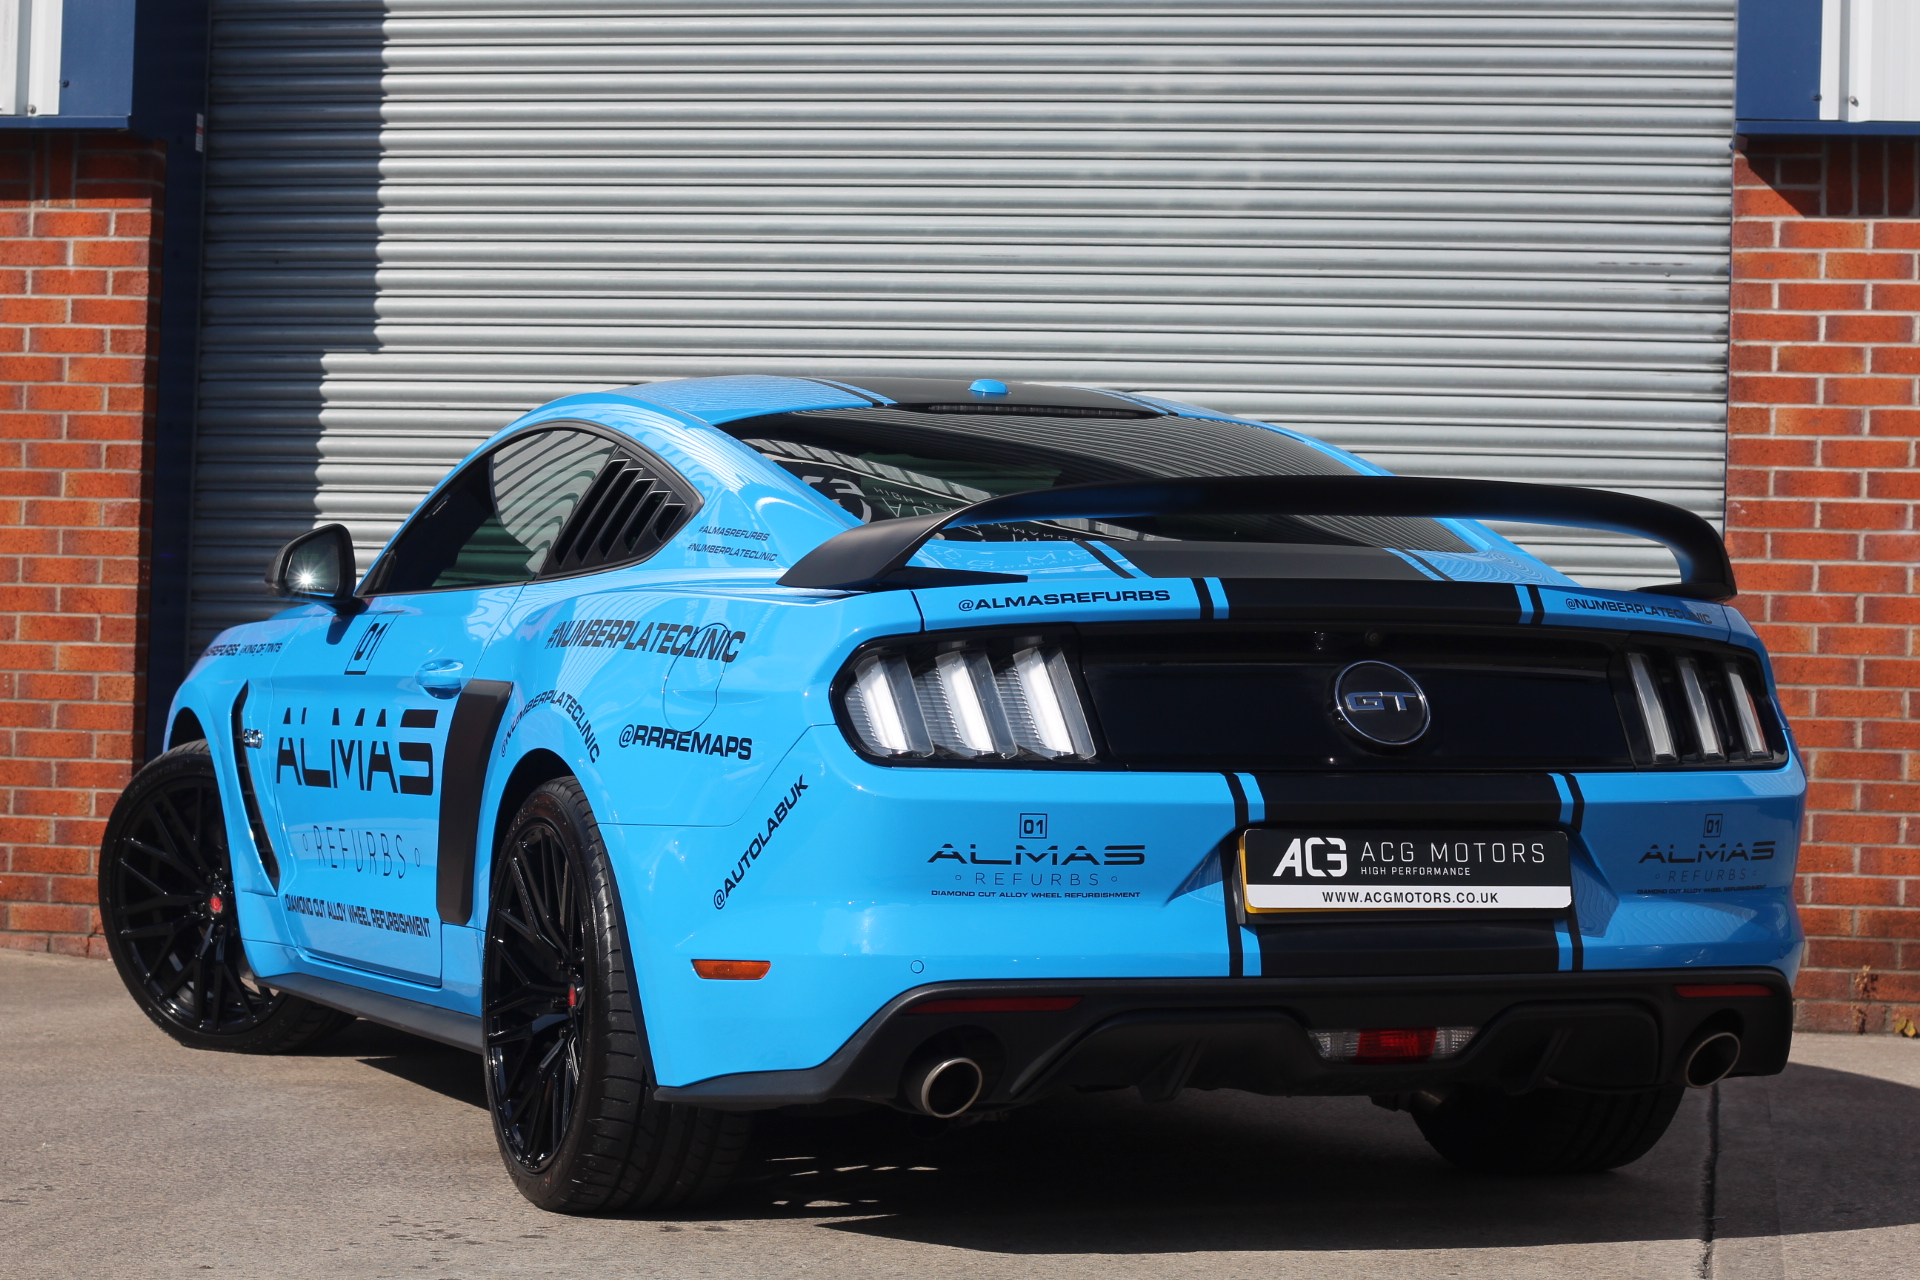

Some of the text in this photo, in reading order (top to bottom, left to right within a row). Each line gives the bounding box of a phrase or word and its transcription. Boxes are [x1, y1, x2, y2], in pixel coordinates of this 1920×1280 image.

[699, 525, 770, 542] #ALMASREFURBS
[687, 543, 778, 562] #NUMBERPLATECLINIC
[958, 589, 1171, 612] @ALMASREFURBS
[1565, 597, 1713, 624] @NUMBERPLATECLINIC
[353, 622, 389, 661] 01
[544, 619, 747, 663] #NUMBERPLATECLINIC
[1345, 691, 1417, 712] GT
[276, 707, 439, 796] ALMAS
[618, 723, 753, 760] @RRREMAPS
[1023, 819, 1044, 834] 01
[1705, 819, 1720, 834] 01
[313, 825, 406, 879] REFURBS
[713, 773, 809, 910] @AUTOLABUK
[1638, 841, 1776, 863] ALMAS
[927, 843, 1146, 865] ALMAS
[1361, 842, 1545, 863] ACG MOTORS
[975, 872, 1099, 886] REFURBS
[1361, 867, 1471, 876] HIGH PERFORMANCE
[1668, 868, 1747, 883] REFURBS
[931, 889, 975, 897] DIAMOND
[1322, 891, 1499, 904] WWW.ACGMOTORS.CO.UK
[285, 893, 431, 938] DIAMOND CUT ALLOY WHEEL REFURBISHMENT
